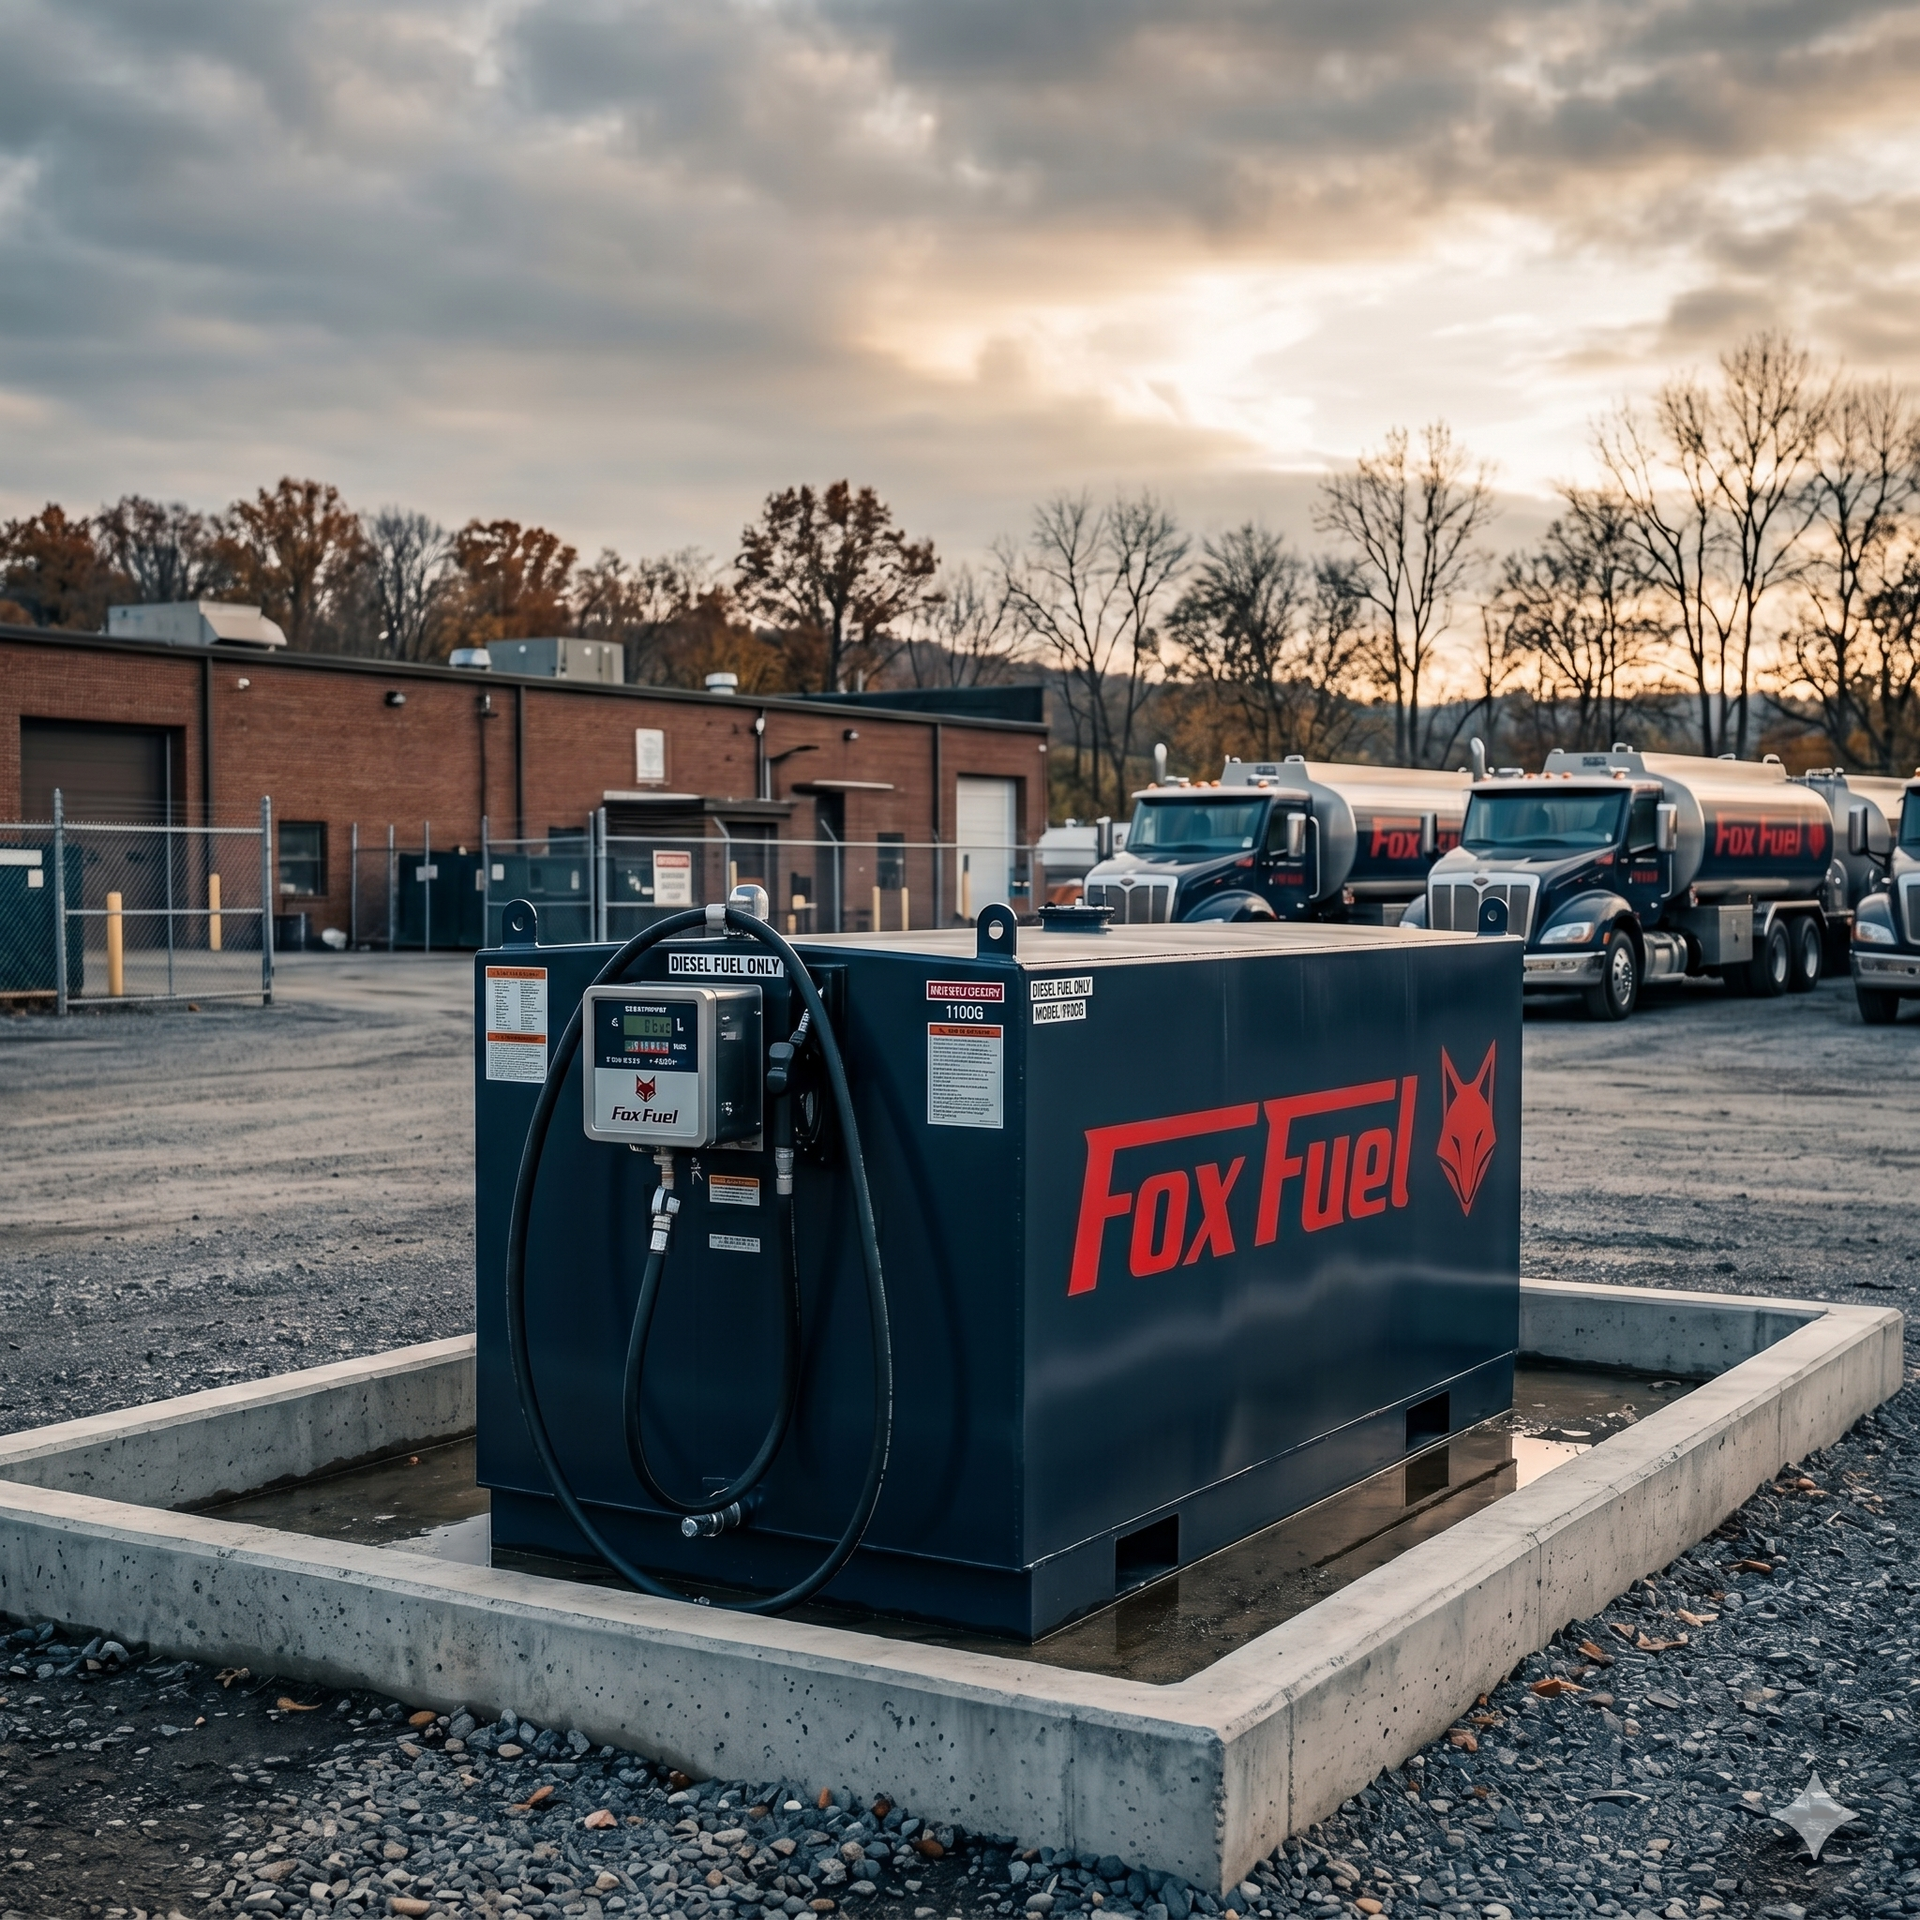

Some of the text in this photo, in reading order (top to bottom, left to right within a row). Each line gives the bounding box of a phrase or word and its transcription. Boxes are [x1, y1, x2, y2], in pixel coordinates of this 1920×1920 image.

[1370, 816, 1420, 859] Fox
[1715, 811, 1801, 857] Fox Fuel
[671, 956, 780, 975] DIESEL FUEL ONLY
[1032, 982, 1056, 998] DIESEL
[1057, 980, 1073, 996] FUEL
[946, 1004, 984, 1020] 1100G
[611, 1105, 679, 1124] Fox Fuel
[1067, 1075, 1419, 1297] Fox Fuel
